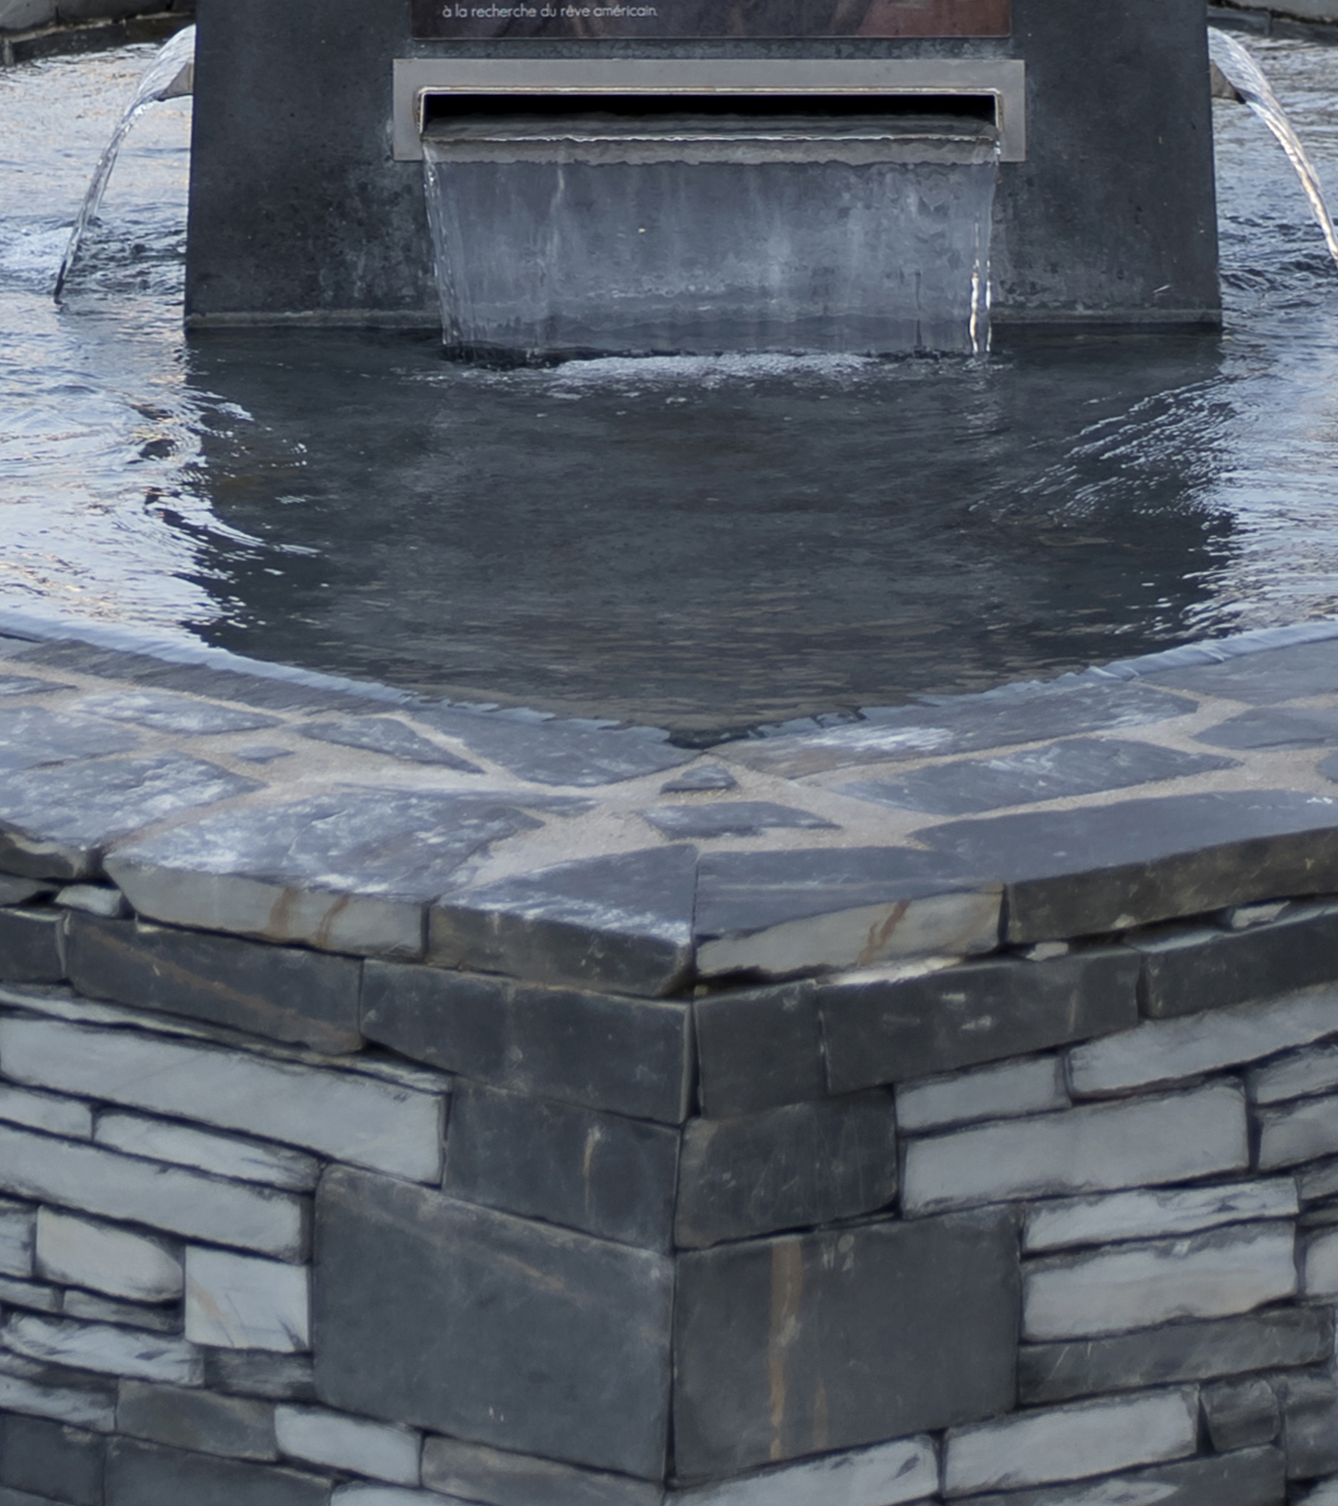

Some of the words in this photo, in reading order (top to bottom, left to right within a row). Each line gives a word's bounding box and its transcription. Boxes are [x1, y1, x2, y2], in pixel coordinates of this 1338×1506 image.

[442, 4, 452, 17] à
[455, 2, 468, 17] la
[471, 2, 537, 17] recherche
[541, 2, 557, 17] du
[560, 2, 590, 17] rêve
[593, 2, 659, 17] américain.
